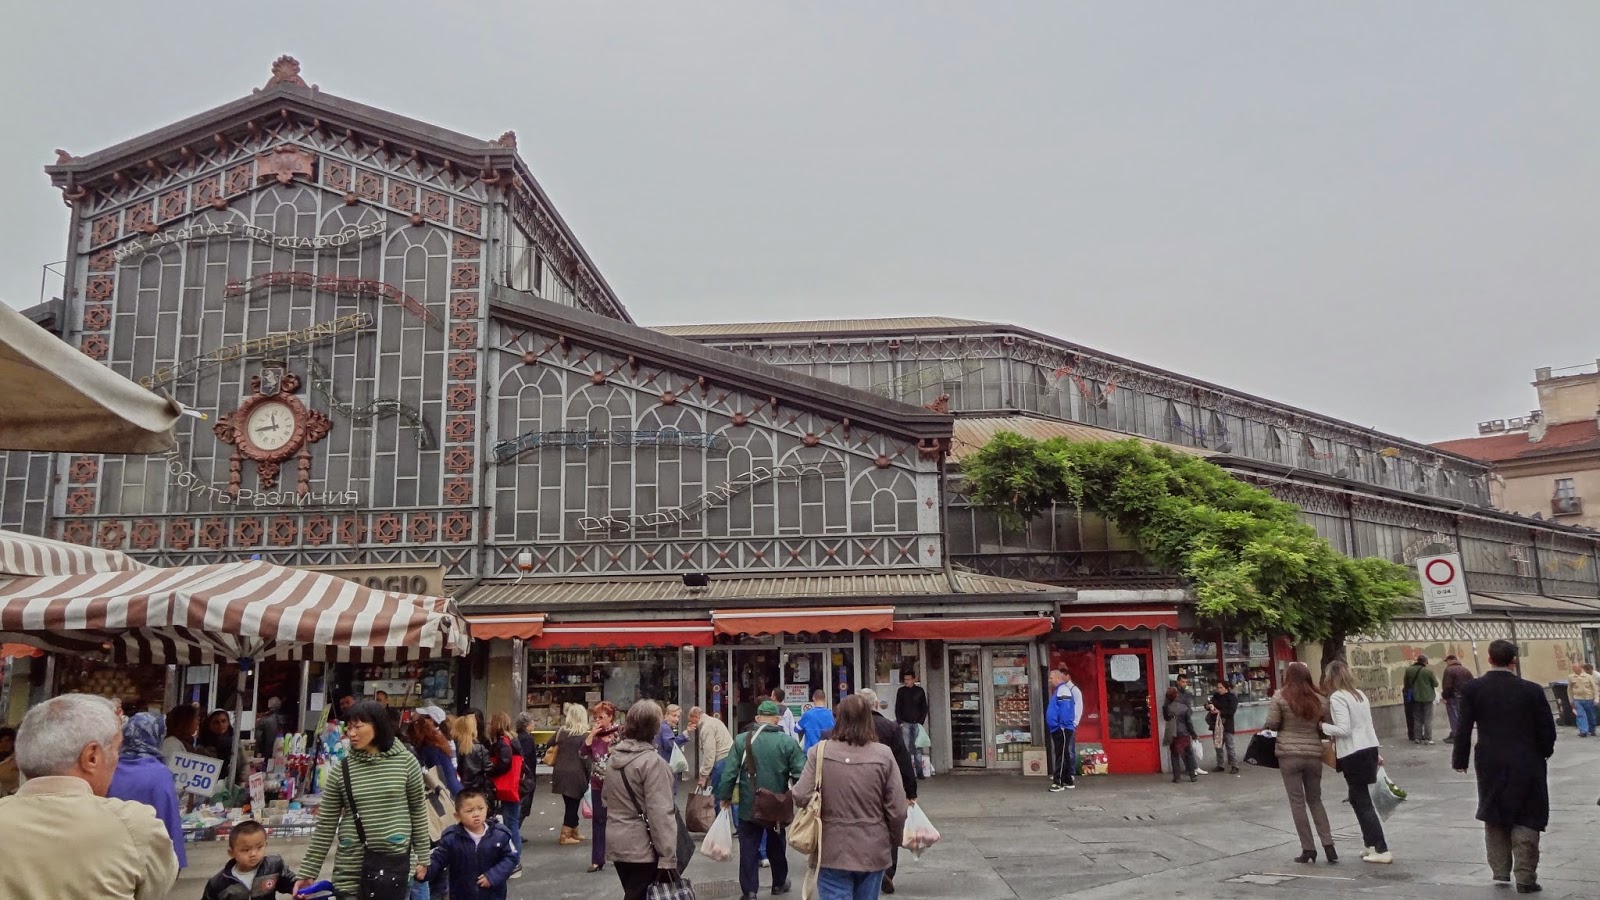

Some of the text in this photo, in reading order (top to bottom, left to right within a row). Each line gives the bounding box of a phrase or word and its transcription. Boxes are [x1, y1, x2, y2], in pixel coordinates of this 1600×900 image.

[236, 488, 359, 507] Различия
[353, 574, 427, 595] OGIO
[174, 756, 216, 774] TUTTO
